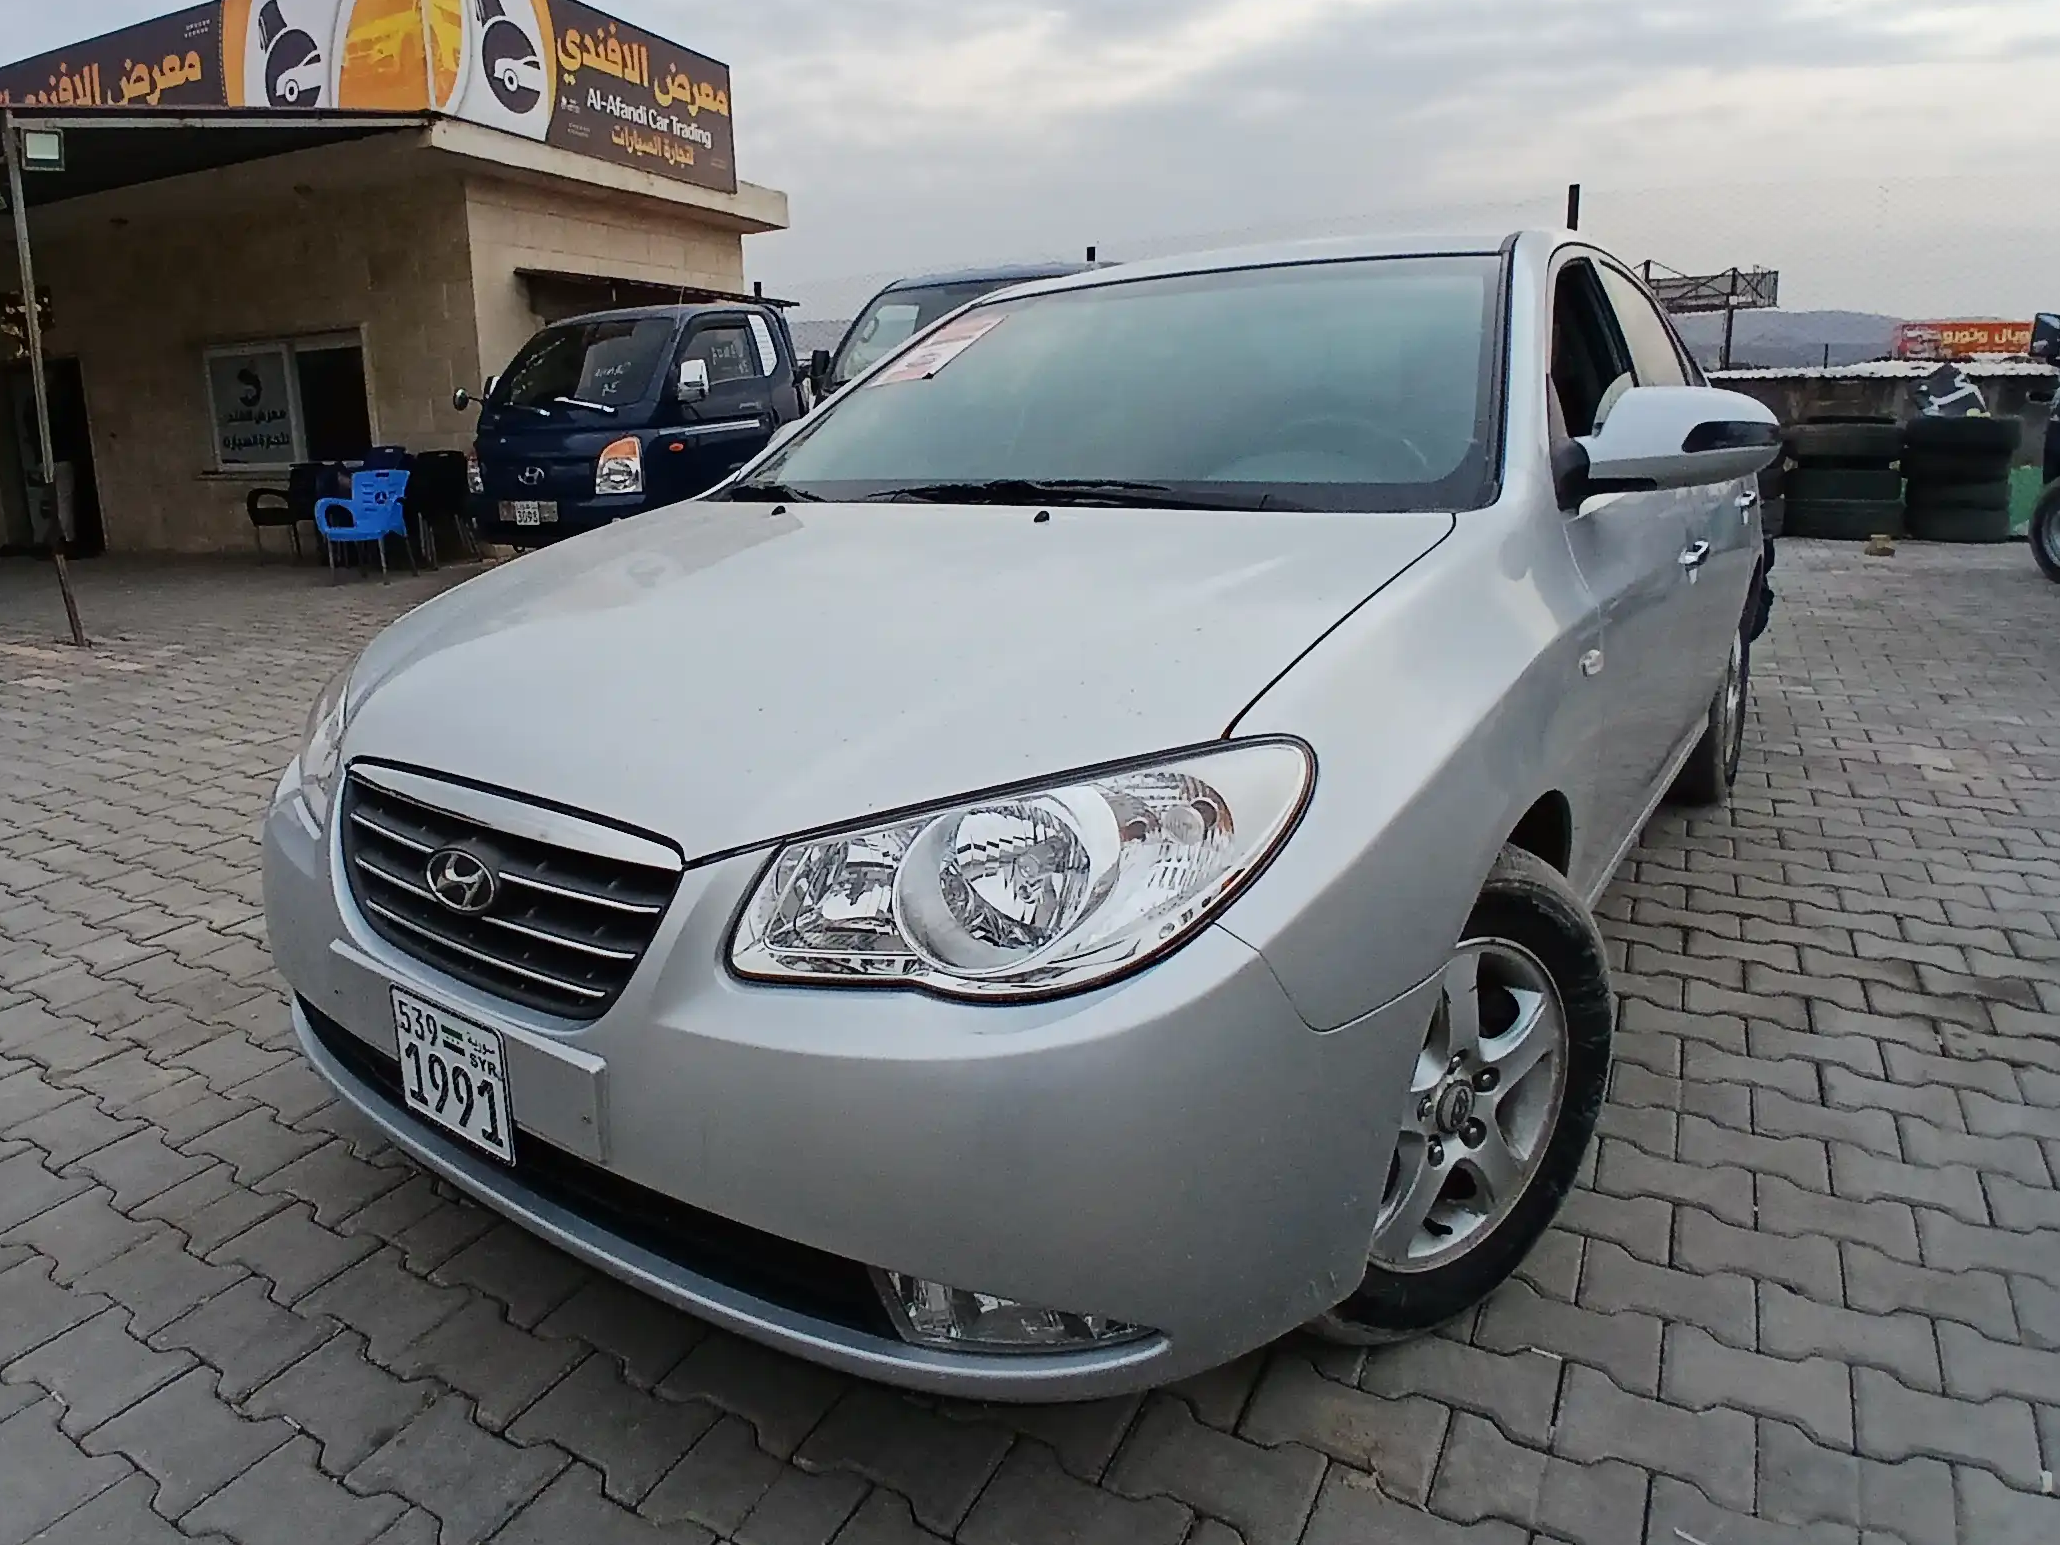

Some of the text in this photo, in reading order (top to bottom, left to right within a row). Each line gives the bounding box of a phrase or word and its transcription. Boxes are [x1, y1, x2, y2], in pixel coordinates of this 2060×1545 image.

[107, 50, 202, 106] معرض
[557, 22, 729, 117] معرض الافندي
[586, 88, 648, 127] Al-Afandi
[648, 108, 670, 132] Car
[669, 114, 712, 149] Trading
[611, 125, 662, 157] السيارات
[398, 999, 438, 1047] 539
[469, 1052, 499, 1077] SYR
[404, 1041, 504, 1149] 1991
